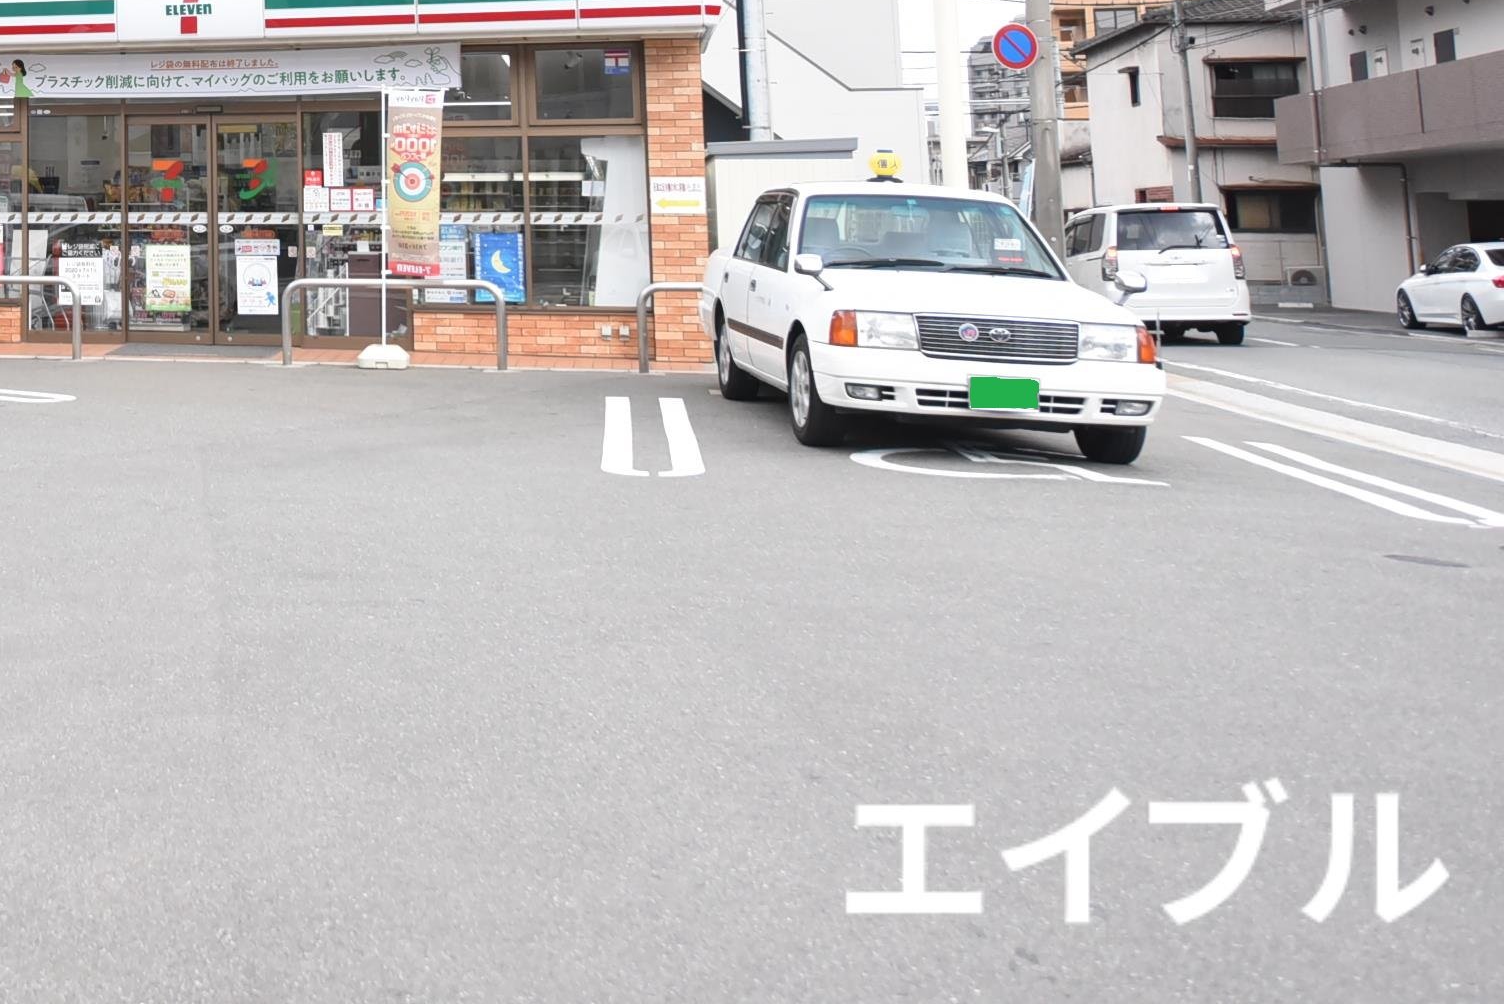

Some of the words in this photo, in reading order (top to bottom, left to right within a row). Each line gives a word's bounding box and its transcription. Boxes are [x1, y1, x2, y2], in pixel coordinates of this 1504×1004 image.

[34, 66, 407, 90] プラスチック削減に向けて、マイバッグのご利用をお願いします。
